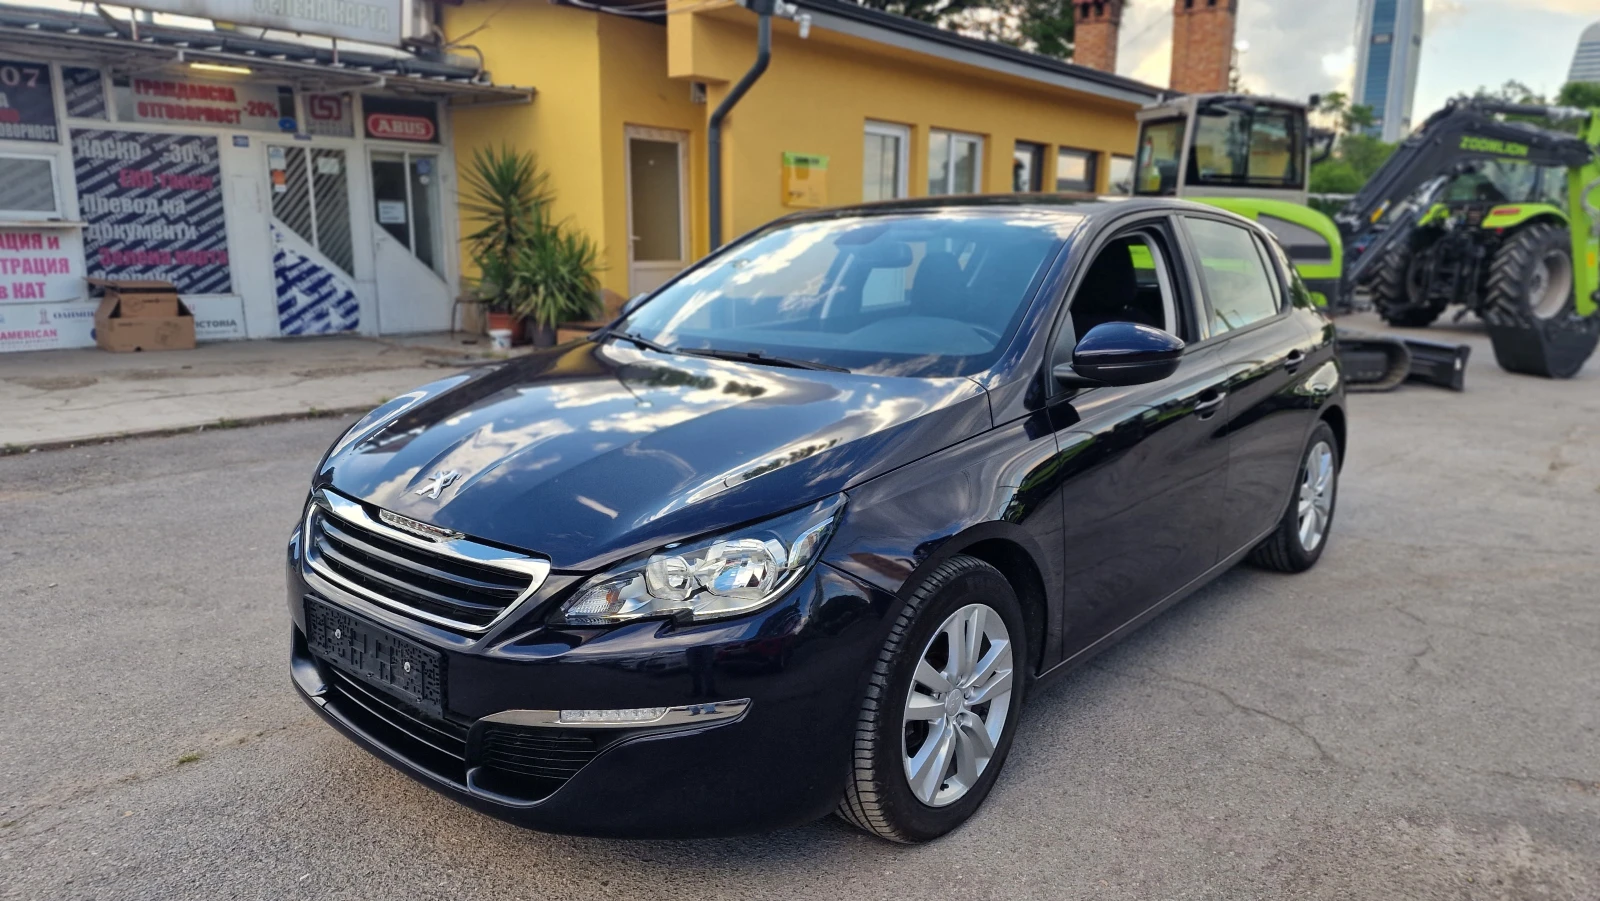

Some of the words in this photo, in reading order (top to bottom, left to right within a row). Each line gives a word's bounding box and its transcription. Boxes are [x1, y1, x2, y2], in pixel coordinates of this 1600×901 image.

[331, 1, 390, 33] КАРТА
[0, 66, 39, 87] 07
[138, 102, 241, 124] ОТГОВОРНОСТ
[377, 120, 425, 135] ABUS
[80, 136, 141, 161] КАСКО
[163, 139, 210, 164] -30%
[1459, 135, 1529, 156] ZOOMLION
[82, 193, 160, 216] Превод
[12, 281, 46, 299] КАТ
